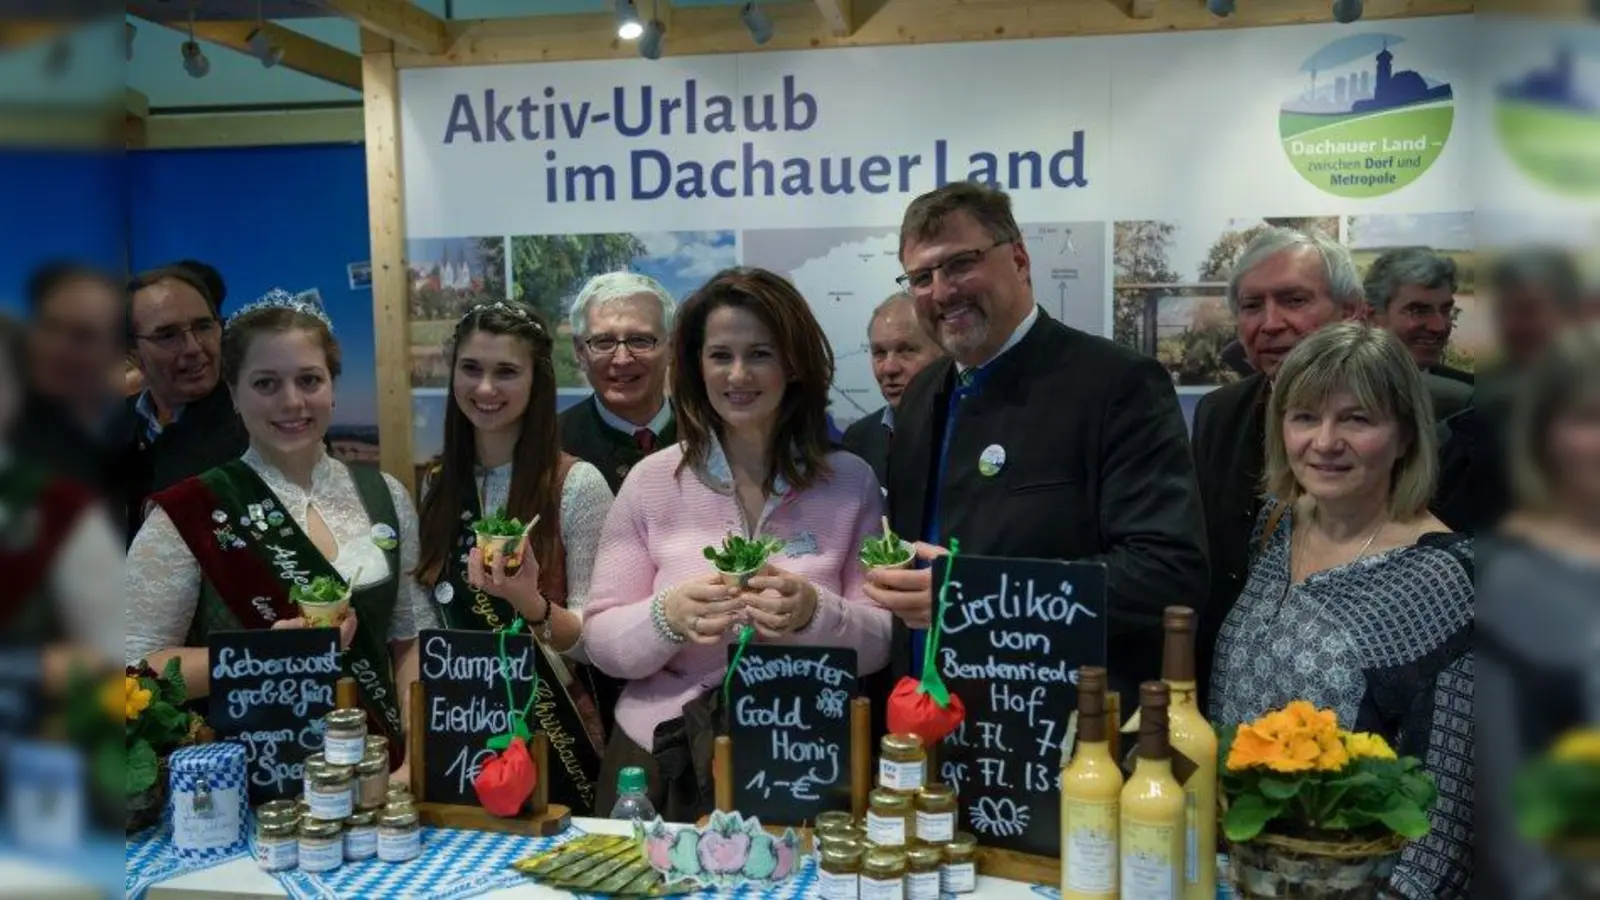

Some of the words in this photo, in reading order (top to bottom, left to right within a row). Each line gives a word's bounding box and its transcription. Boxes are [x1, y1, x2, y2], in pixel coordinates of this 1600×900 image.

[443, 75, 818, 143] Aktiv-Urlaub
[1291, 138, 1376, 156] Dachauer
[1382, 135, 1427, 151] Land
[1308, 159, 1361, 172] zwischen
[1365, 156, 1394, 169] Dorf
[1398, 155, 1421, 168] und
[544, 150, 616, 203] im
[631, 143, 921, 201] Dachauer
[934, 130, 1088, 190] Land
[1330, 172, 1397, 187] Metropole
[940, 572, 1098, 634] Eierlikör
[989, 629, 1051, 654] vom
[423, 636, 534, 690] Stamperl
[940, 648, 1081, 685] Bendenriede
[431, 696, 525, 734] Eierlikör
[736, 694, 812, 730] Gold
[990, 682, 1047, 727] Hof
[252, 756, 305, 794] Spe
[772, 729, 840, 785] Honig
[1025, 761, 1061, 793] 13
